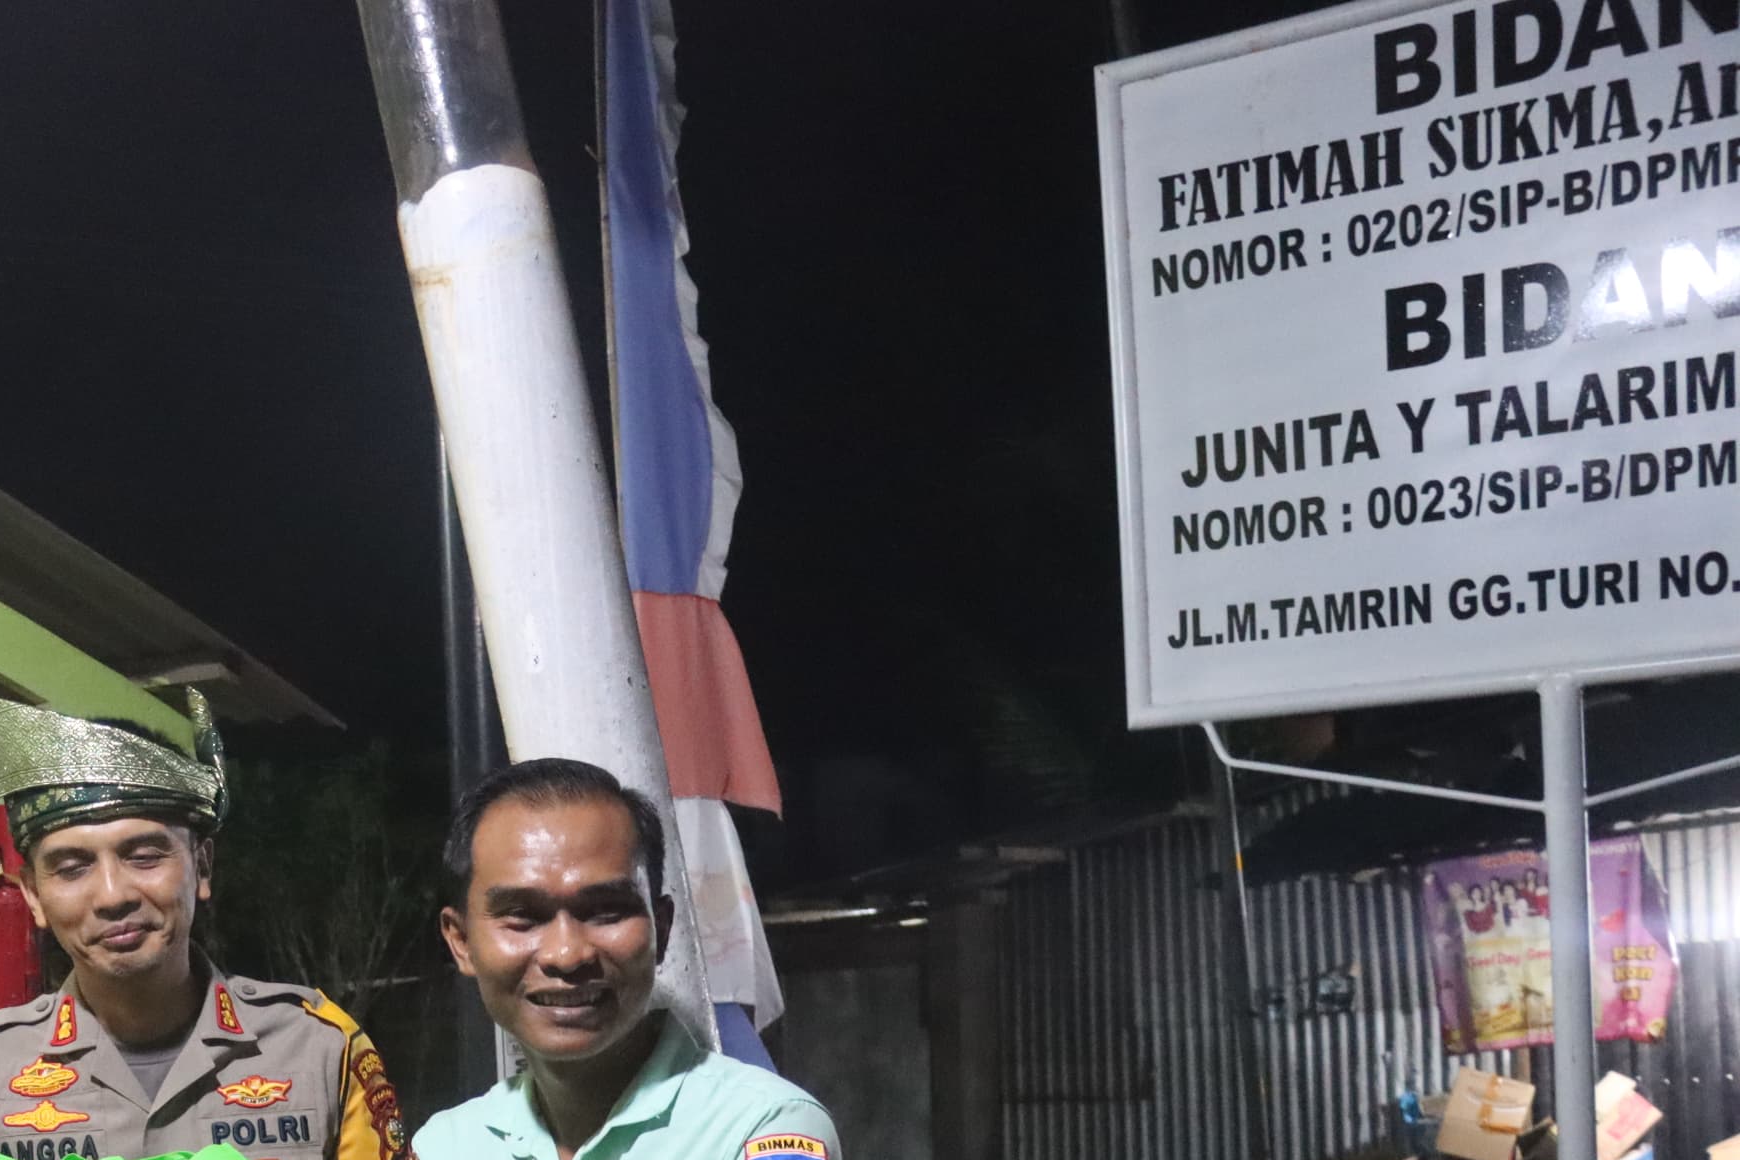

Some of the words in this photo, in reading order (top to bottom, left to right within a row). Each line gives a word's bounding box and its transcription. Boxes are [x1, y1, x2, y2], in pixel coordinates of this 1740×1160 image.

[1375, 0, 1740, 116] BIDAN
[1158, 127, 1404, 232] FATIMAH
[1151, 228, 1308, 297] NOMOR
[1384, 226, 1740, 372] BIDAN
[1180, 409, 1380, 488] JUNITA
[1396, 398, 1436, 455] Y
[1455, 351, 1736, 446] TALARIM
[1173, 496, 1328, 554] NOMOR
[1367, 440, 1737, 529] 0023/SIP-B/DPM
[1167, 583, 1433, 650] JL.M.TAMRIN
[1448, 560, 1639, 621] GG.TURI
[1659, 551, 1740, 600] NO.
[212, 1115, 311, 1145] POLRI
[757, 1139, 814, 1152] BINMAS
